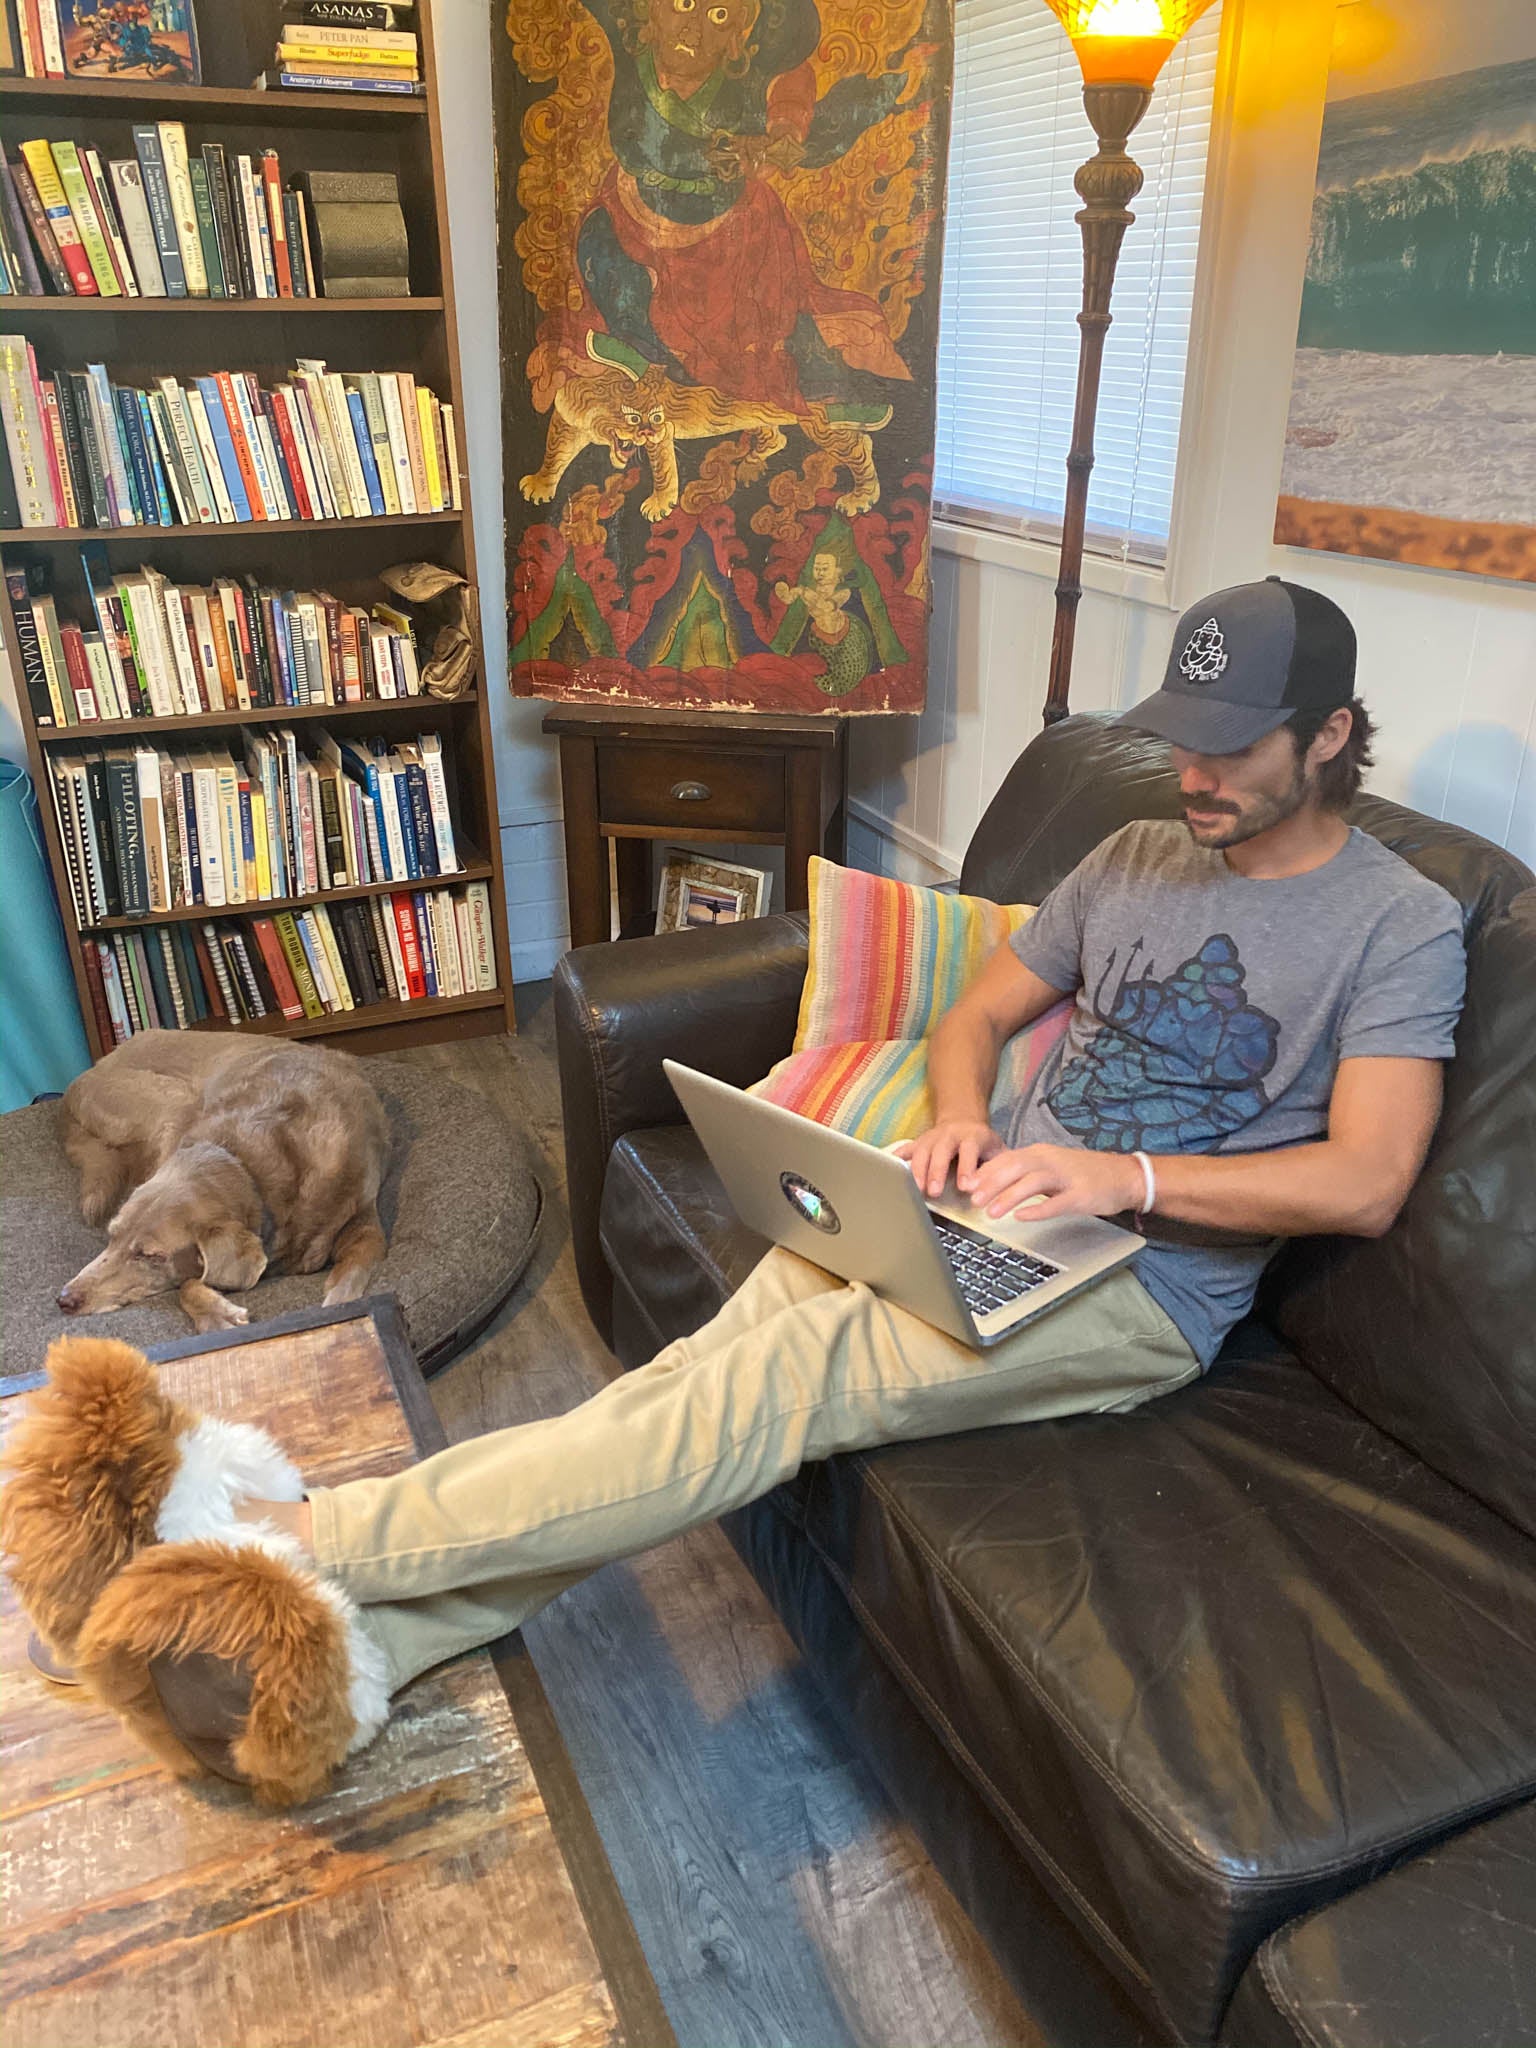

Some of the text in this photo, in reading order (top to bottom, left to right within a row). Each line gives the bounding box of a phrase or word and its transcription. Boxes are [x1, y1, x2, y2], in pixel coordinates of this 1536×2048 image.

[310, 3, 374, 18] ASANAS
[319, 32, 369, 43] PETER PAN
[327, 47, 369, 60] Superfudge
[323, 78, 352, 87] Movement
[214, 166, 222, 178] ART
[218, 191, 230, 223] HAPPINESS
[77, 196, 97, 237] MANDALA
[152, 196, 164, 227] EFFECTIVE
[159, 227, 168, 248] PEOPLE
[236, 379, 249, 404] Dealing
[123, 392, 142, 456] POWER FORCE
[227, 402, 238, 425] GODIN
[242, 404, 252, 419] With
[171, 400, 201, 486] PERFECT HEALTH
[246, 420, 258, 441] People
[238, 441, 251, 476] LINCHPIN
[251, 442, 260, 453] You
[258, 470, 269, 488] Stand
[99, 600, 107, 611] THE
[173, 609, 182, 630] Golden
[102, 613, 112, 631] BOOK
[330, 621, 338, 640] SECRET
[15, 609, 44, 685] HUMAN
[177, 630, 187, 653] Present
[342, 630, 355, 658] CREATIVE
[380, 655, 388, 668] STEPS
[199, 778, 210, 818] CORPORATE
[240, 793, 248, 806] Ask
[398, 777, 410, 827] POWER FORCE
[430, 762, 445, 814] CINEMA ALCHEMIST
[120, 772, 140, 859] PILOTING,
[117, 824, 125, 848] SMALL
[179, 817, 188, 857] ILLUSTRATED
[119, 849, 127, 869] BOAT
[229, 831, 237, 872] COMMUNICATION
[122, 870, 131, 907] HANDLING
[129, 860, 139, 906] SEAMANSHIP
[473, 900, 484, 934] Complete
[282, 917, 303, 968] TONY ROBBINS
[401, 910, 418, 972] THRIVING ON CHAOS
[477, 936, 487, 964] Walker
[300, 969, 316, 1002] MONEY
